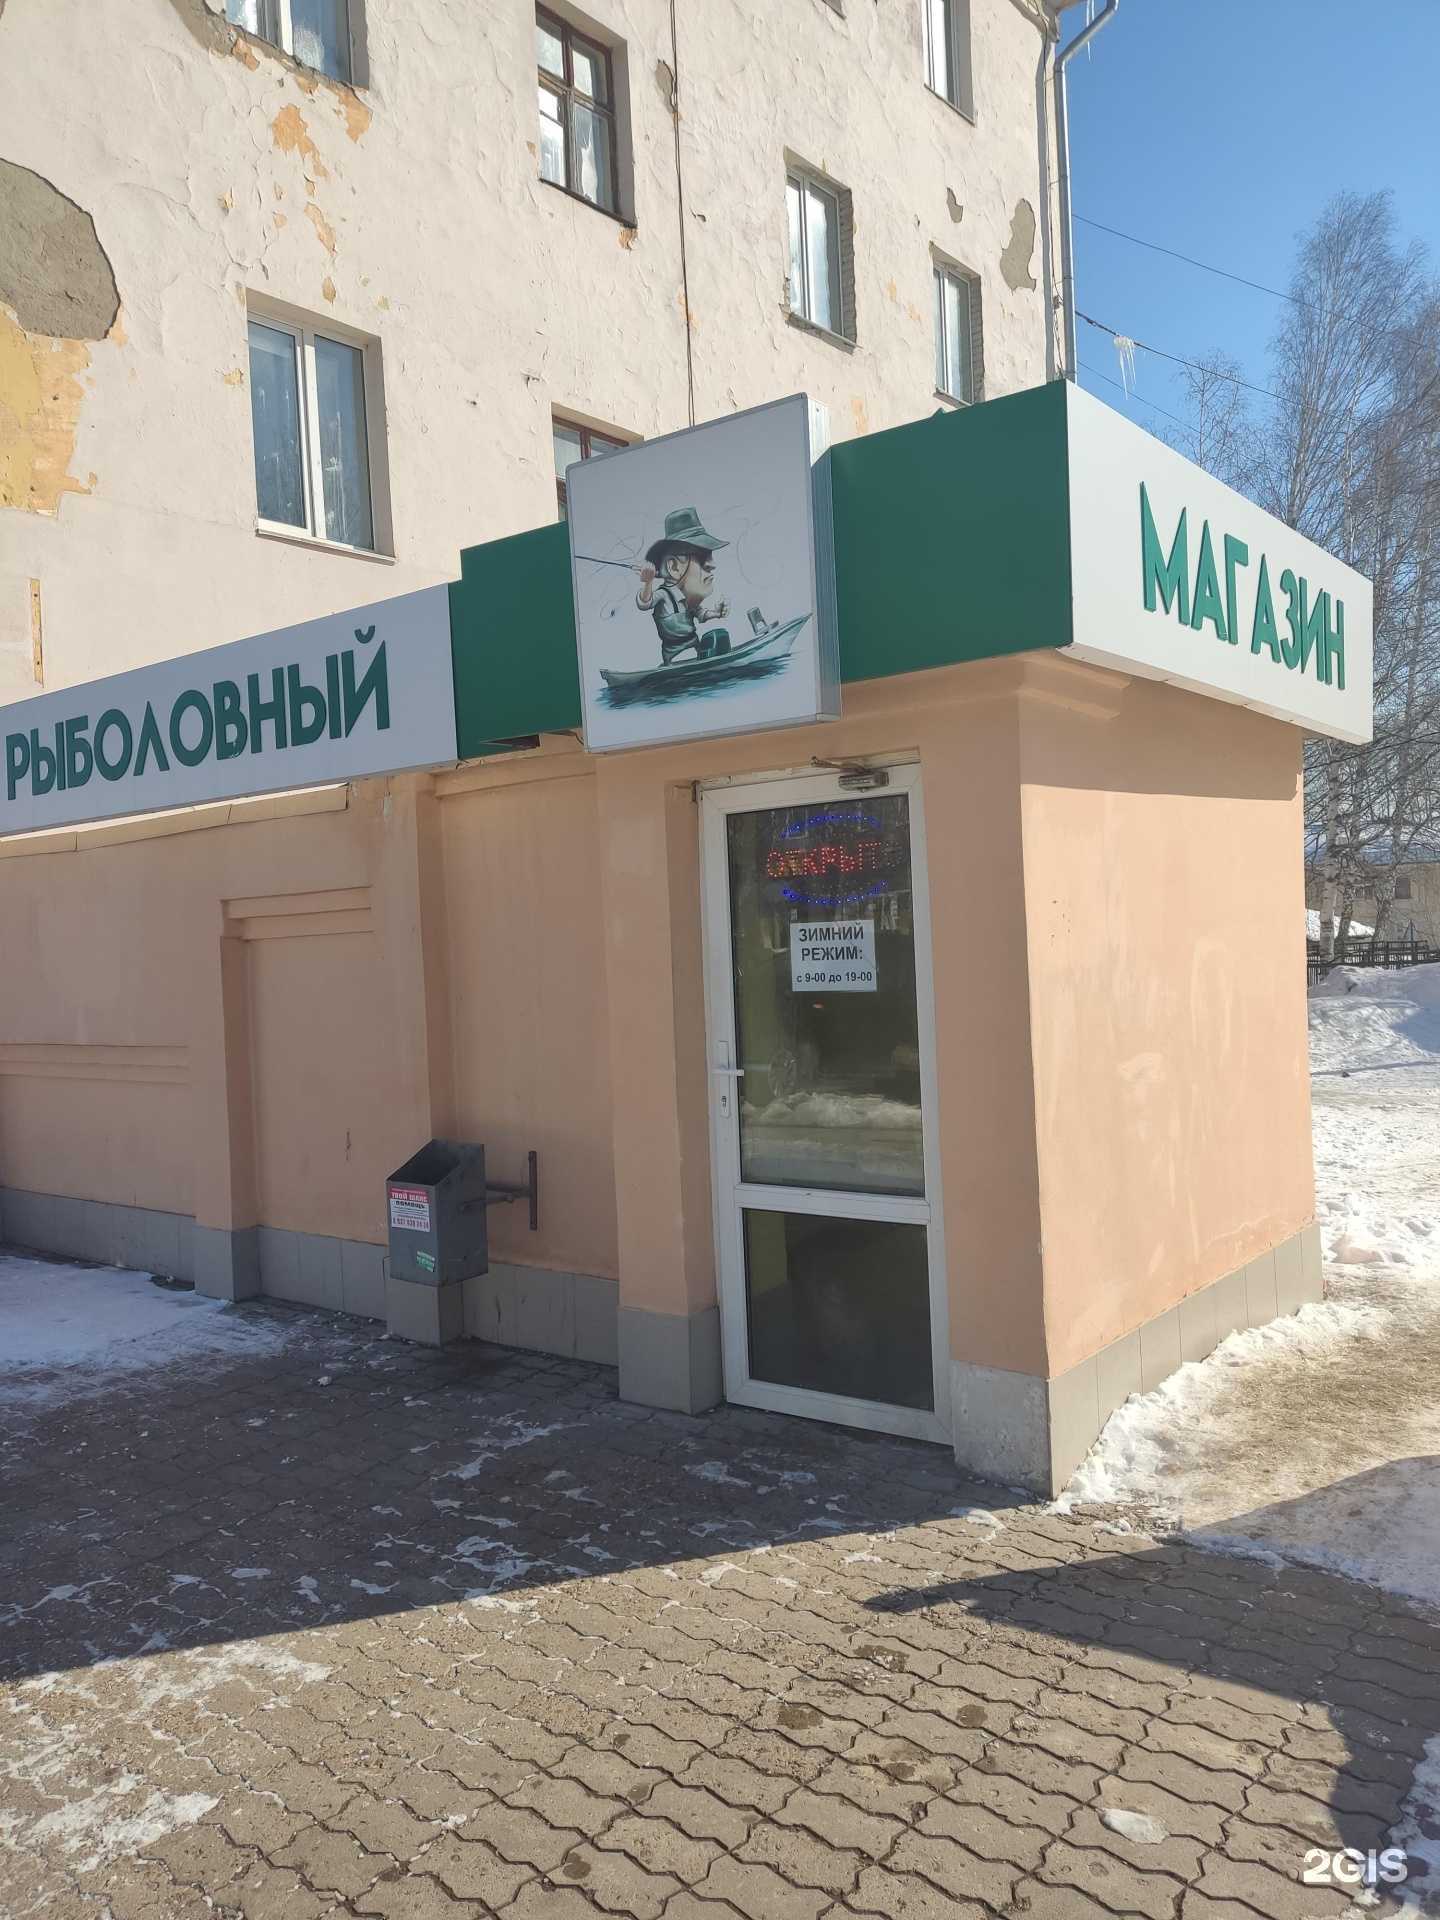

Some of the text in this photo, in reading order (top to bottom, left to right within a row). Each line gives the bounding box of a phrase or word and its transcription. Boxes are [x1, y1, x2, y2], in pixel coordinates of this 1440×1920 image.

[1140, 481, 1345, 690] МАГАЗИН
[6, 625, 391, 800] РЫБОЛОВНЫЙ
[799, 922, 864, 942] ЗИМНИЙ
[801, 945, 863, 961] РЕЖИМ:
[805, 972, 826, 983] 9-00
[828, 974, 842, 984] до
[846, 971, 872, 982] 19-00
